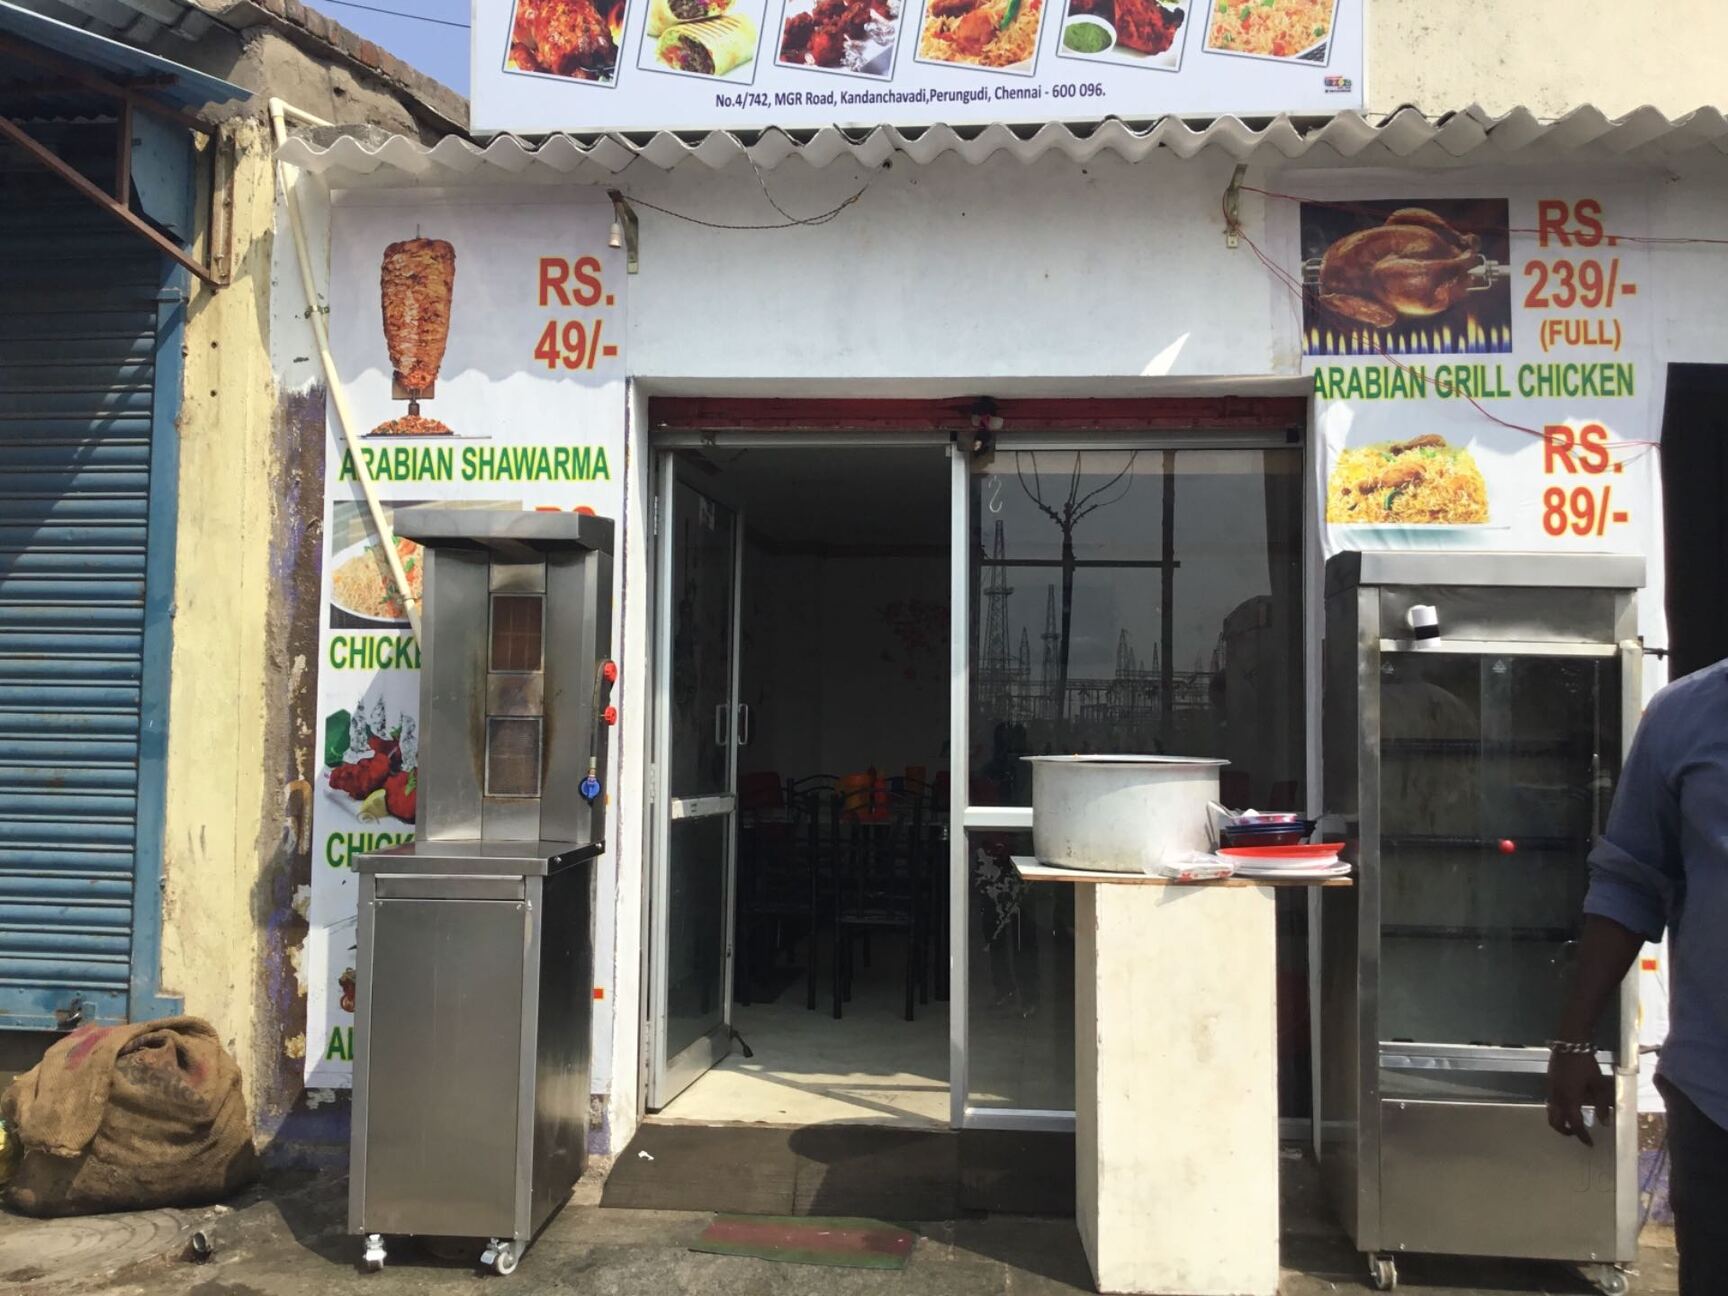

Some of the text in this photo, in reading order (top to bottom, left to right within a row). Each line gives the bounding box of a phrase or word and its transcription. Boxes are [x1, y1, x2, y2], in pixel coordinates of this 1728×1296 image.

[715, 92, 772, 109] No.4/742,
[774, 91, 803, 106] MGR
[805, 91, 837, 107] Road,
[994, 85, 1042, 100] Chennai
[1052, 83, 1077, 98] 600
[1079, 82, 1106, 97] 096.
[1538, 199, 1617, 247] RS.
[538, 256, 615, 307] RS.
[1523, 258, 1637, 309] 239/-
[534, 319, 618, 370] 49/-
[1540, 318, 1621, 351] (FULL)
[1313, 362, 1634, 400] ARABIAN GRILL CHICKEN
[339, 446, 610, 481] ARABIAN SHAWARMA
[1543, 423, 1623, 475] RS.
[1542, 485, 1629, 537] 89/-
